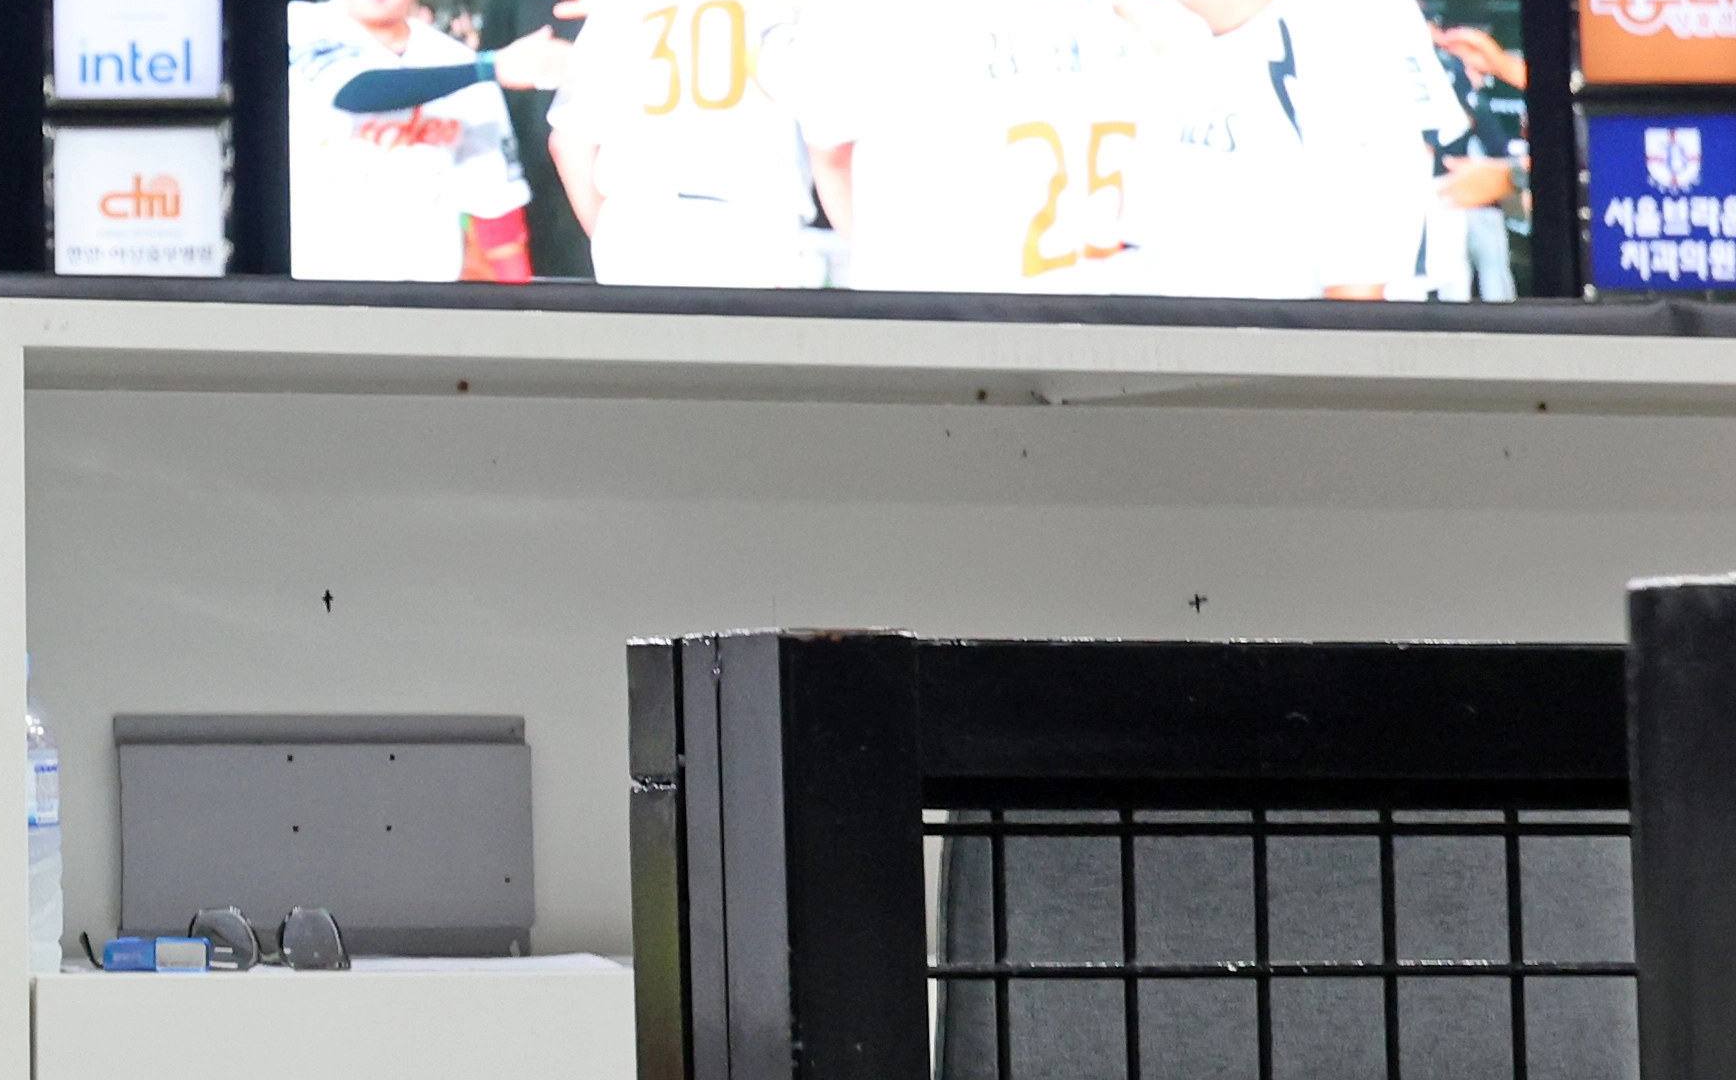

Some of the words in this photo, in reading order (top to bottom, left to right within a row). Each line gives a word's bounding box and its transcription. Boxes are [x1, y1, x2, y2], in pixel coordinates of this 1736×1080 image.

[79, 39, 192, 84] intel
[1006, 121, 1137, 277] 25
[1620, 239, 1736, 282] 치과의원
